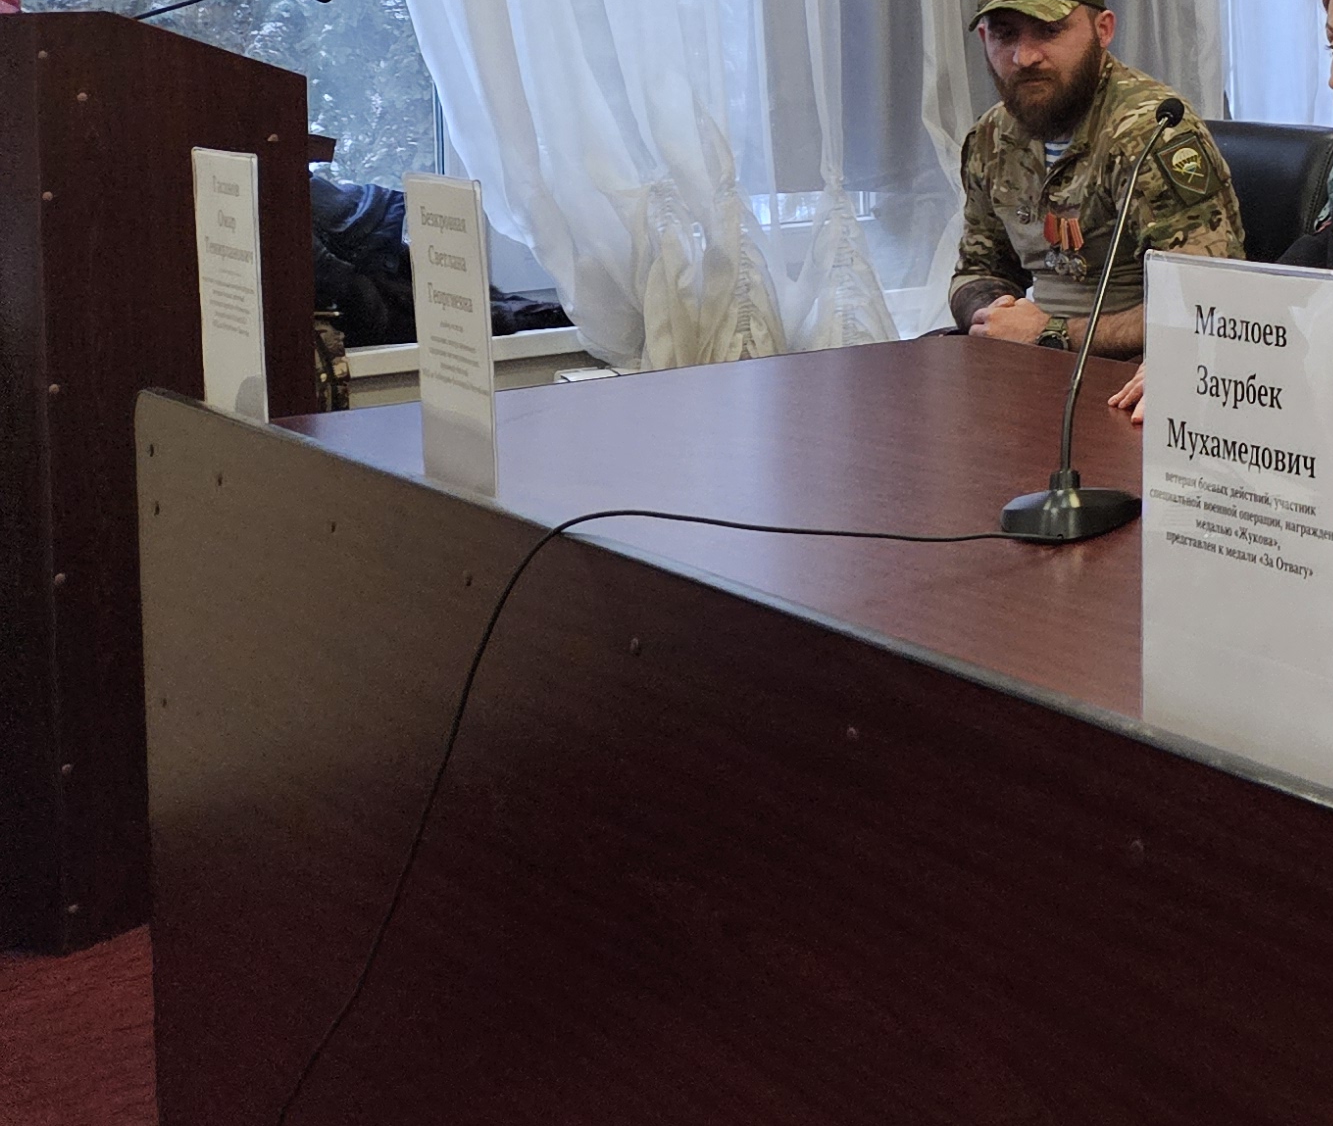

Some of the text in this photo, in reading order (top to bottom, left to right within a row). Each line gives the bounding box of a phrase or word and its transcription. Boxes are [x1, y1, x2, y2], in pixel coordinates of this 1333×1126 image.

[1194, 304, 1287, 348] Мазлоев
[1196, 364, 1283, 410] Заурбек
[1166, 417, 1316, 479] Мухамедович
[1165, 472, 1197, 489] ветеран
[1198, 477, 1228, 496] боевых
[1274, 496, 1317, 516] участник
[1203, 501, 1238, 519] военной
[1196, 519, 1232, 537] медалью
[1166, 530, 1313, 579] представлен к медали «За Отвагу»
